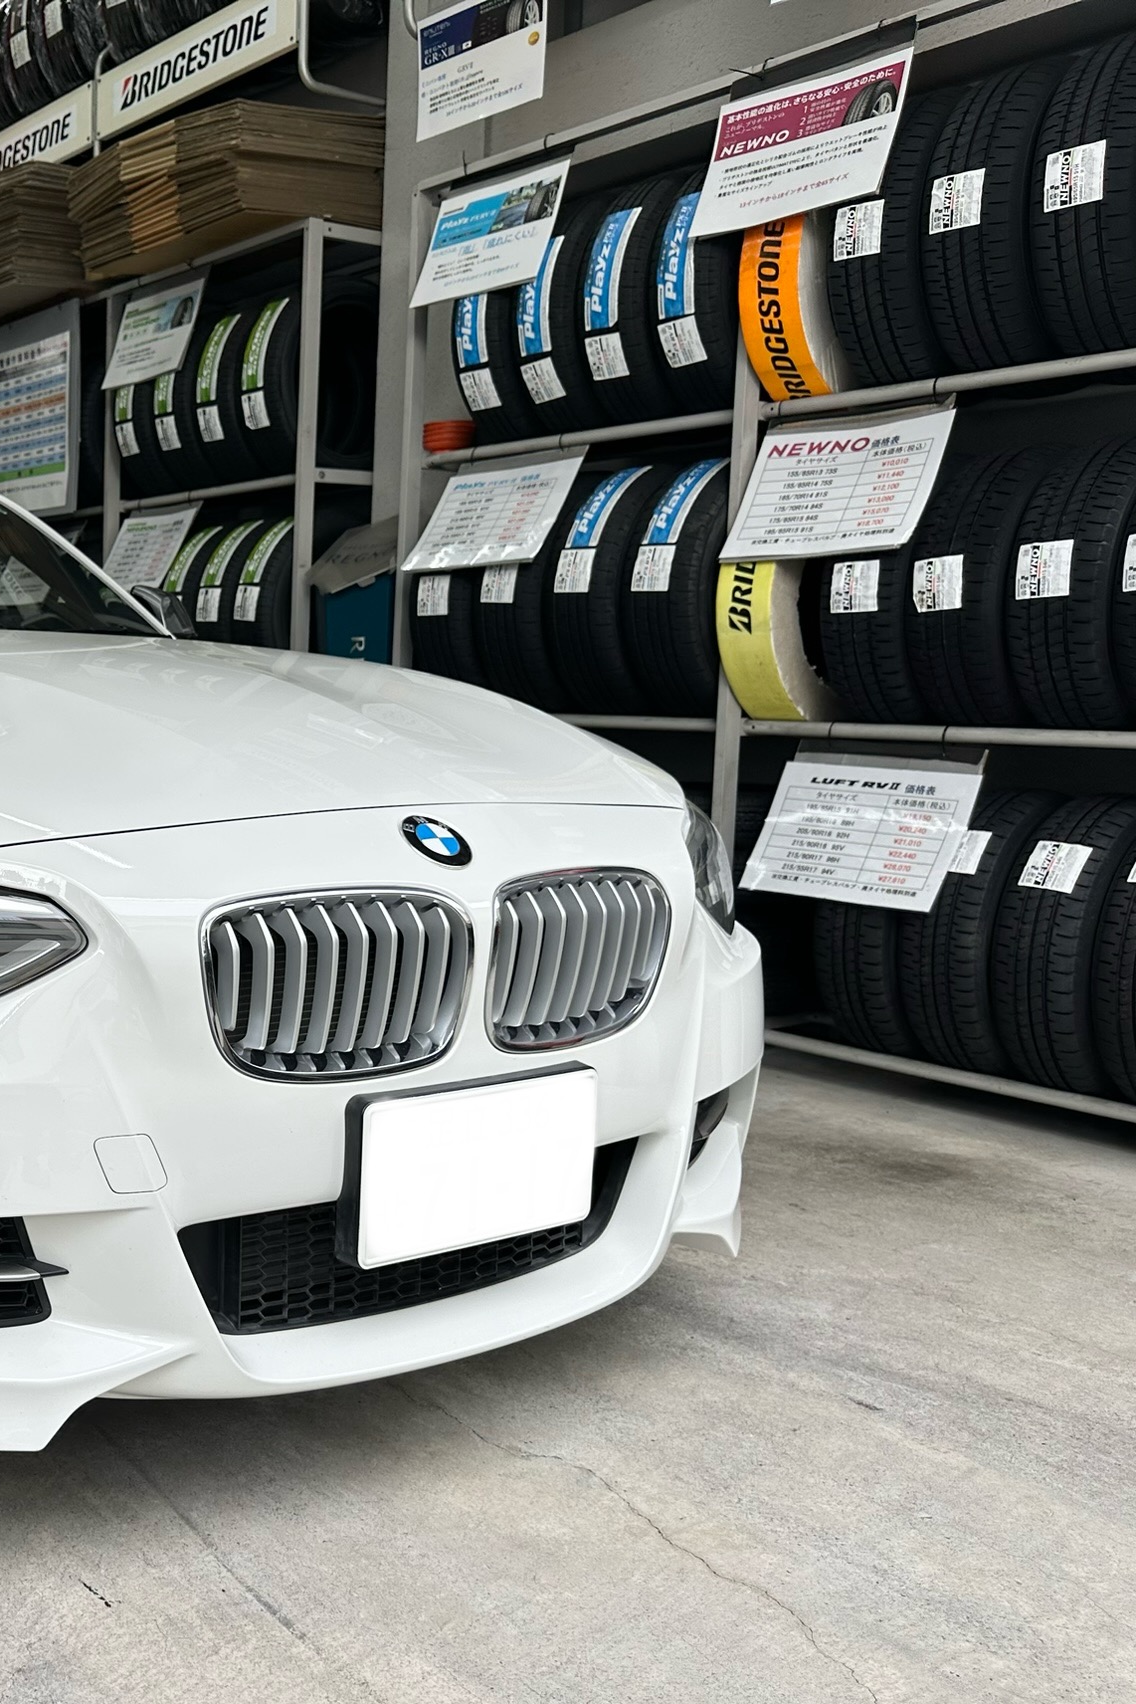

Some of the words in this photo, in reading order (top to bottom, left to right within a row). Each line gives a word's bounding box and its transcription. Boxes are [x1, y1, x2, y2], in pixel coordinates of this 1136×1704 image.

[121, 6, 269, 111] BRIDGESTONE
[720, 129, 790, 158] NEWNO
[942, 179, 954, 225] NEWNO
[1060, 154, 1071, 201] NEWNO
[845, 208, 857, 252] NEWNO
[591, 244, 612, 313] Playz
[665, 228, 685, 300] Playz
[461, 296, 473, 351] Play
[523, 282, 536, 339] Play
[758, 221, 811, 400] RIDGESTONE
[768, 437, 870, 458] NEWNO
[871, 435, 900, 448] 価格表
[577, 480, 616, 534] Playz
[656, 475, 696, 530] Playz
[1030, 548, 1040, 591] NEWNO
[728, 562, 756, 634] BRID
[810, 777, 860, 788] LUFT
[904, 784, 936, 796] 価格表
[1037, 848, 1057, 879] NEWNO
